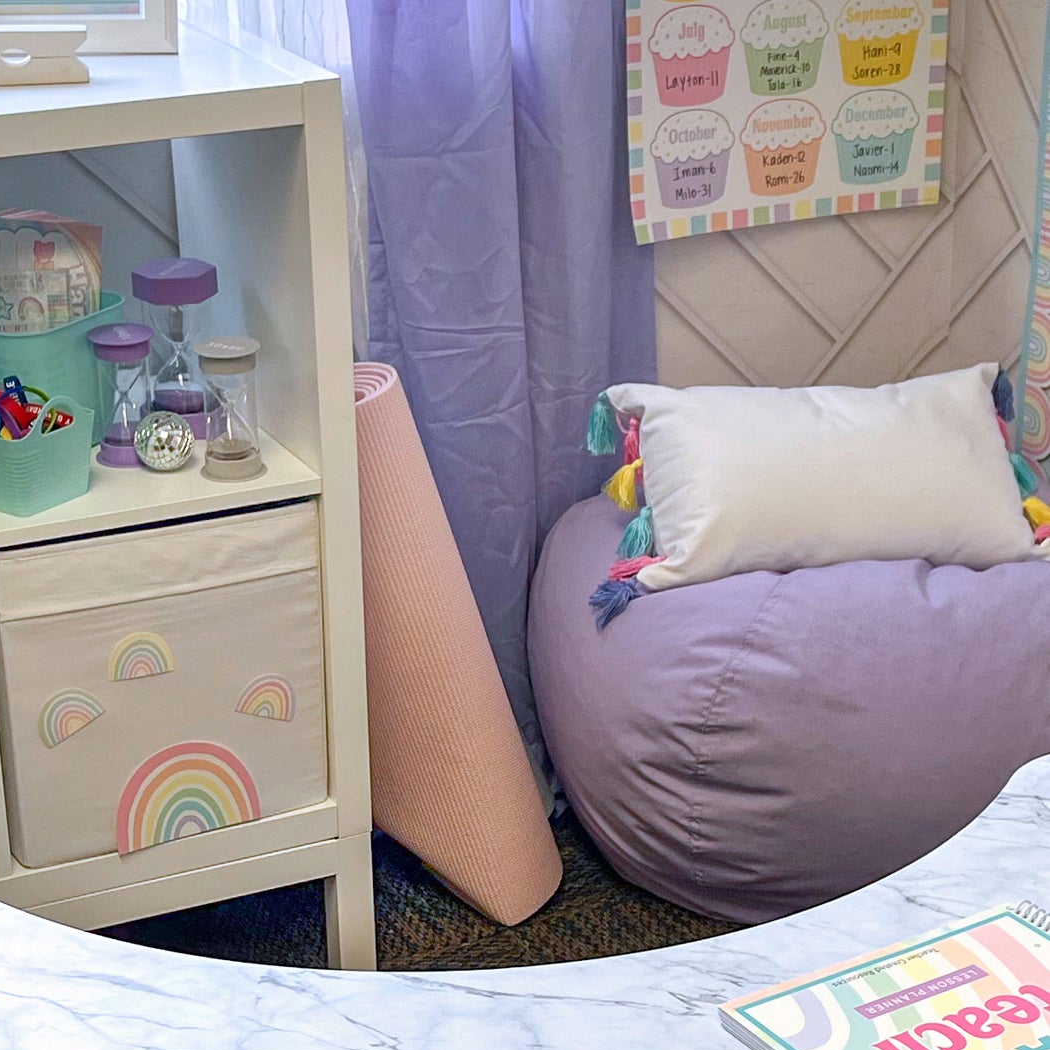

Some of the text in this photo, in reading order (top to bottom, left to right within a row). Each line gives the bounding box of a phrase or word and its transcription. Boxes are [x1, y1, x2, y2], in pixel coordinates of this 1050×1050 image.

[763, 13, 807, 33] August
[846, 5, 915, 25] September
[678, 22, 705, 42] July
[845, 104, 909, 124] December
[752, 114, 815, 135] November
[669, 125, 718, 145] October
[831, 948, 940, 988] Teacher Created Resources
[865, 968, 979, 1014] LESSON PLANNER
